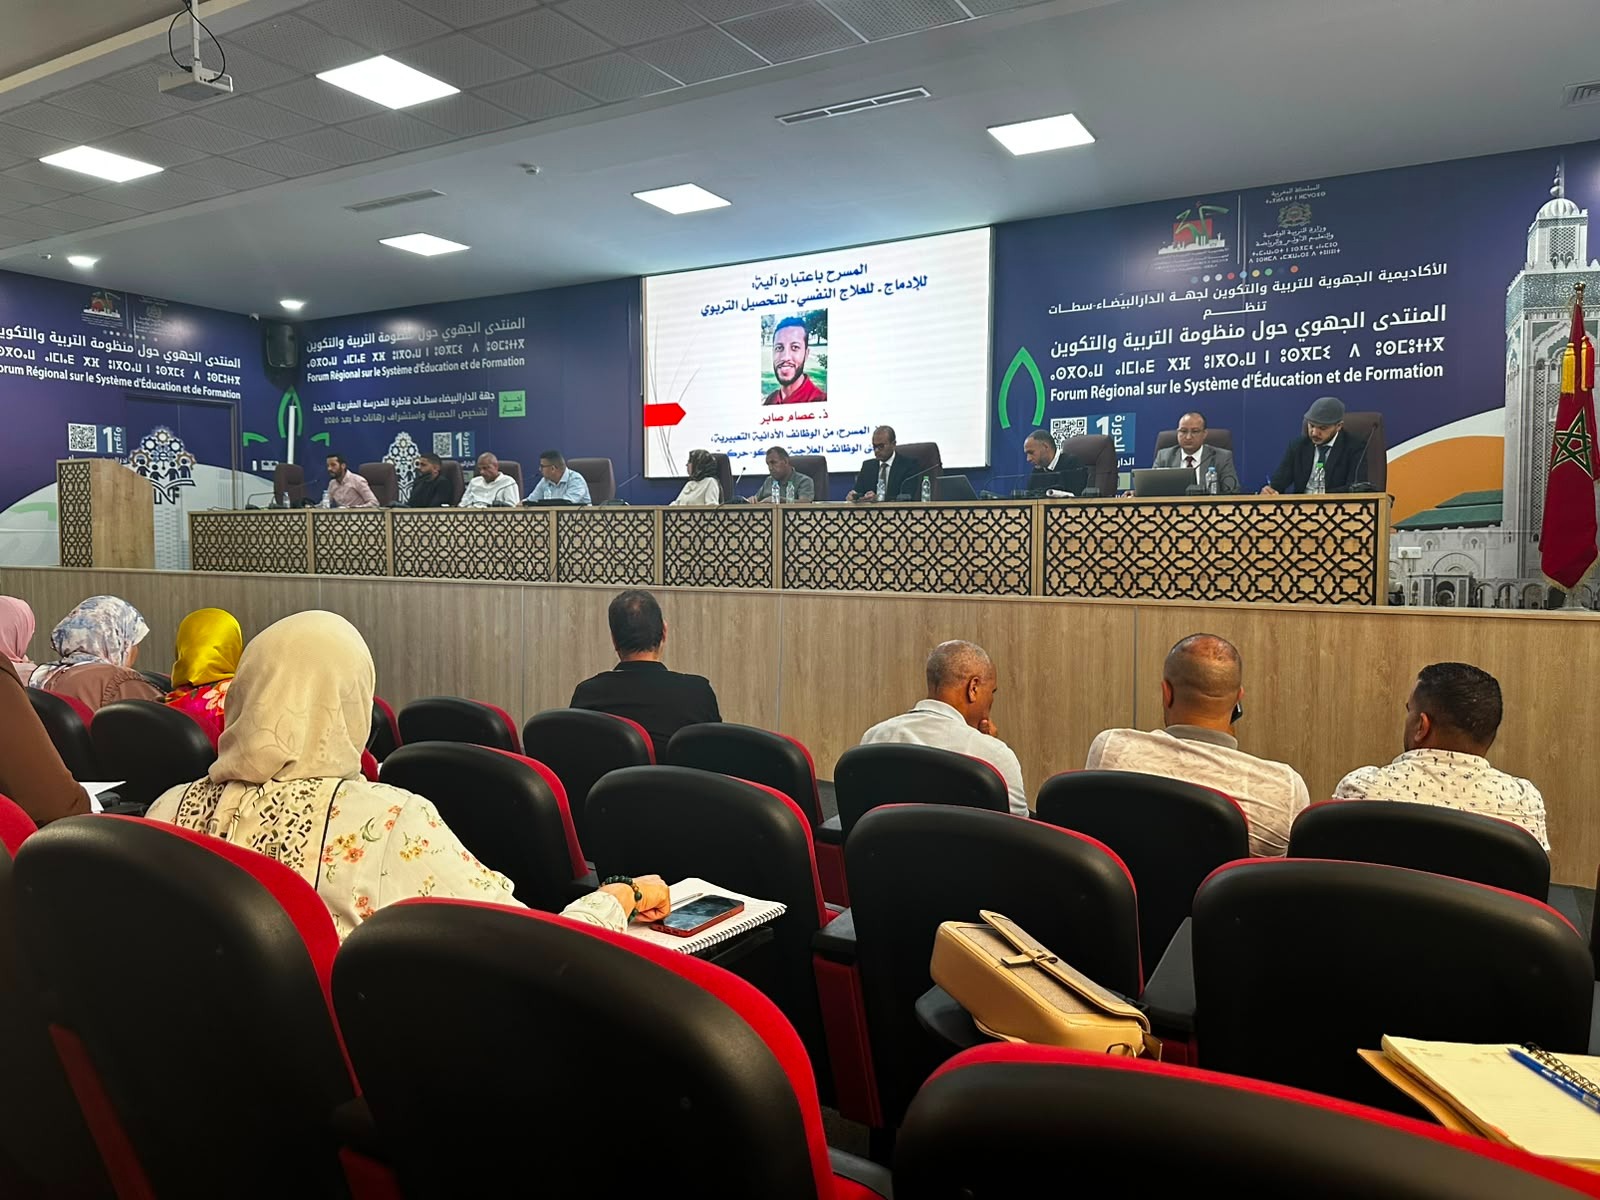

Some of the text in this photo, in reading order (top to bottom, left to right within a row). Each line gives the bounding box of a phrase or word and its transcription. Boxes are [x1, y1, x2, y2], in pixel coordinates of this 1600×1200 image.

[780, 269, 824, 287] باعتباره
[826, 263, 868, 283] المسرح
[1318, 271, 1373, 288] الجهوية
[1378, 263, 1448, 283] الأكاديمية
[840, 282, 874, 301] للعلاج
[884, 275, 928, 294] للإدماج
[1213, 282, 1268, 300] والتكوين
[1272, 277, 1314, 294] للتربية
[741, 294, 788, 311] للتحصيل
[797, 288, 836, 307] النفسي
[700, 300, 739, 317] التربوي
[418, 328, 438, 341] حول
[441, 321, 481, 342] الجهوي
[485, 317, 525, 335] المنتدى
[1050, 304, 1447, 357] المنتدى الجهوي حول منظومة التربية والتكوين
[0, 325, 241, 369] المنتدى الجهوي حول منظومة التربية والتكوي
[306, 336, 345, 353] والتكوين
[347, 332, 375, 348] التربية
[307, 356, 525, 382] Forum Régional sur le Système d'Éducation et de Formation
[0, 364, 241, 399] orum Régional sur le Système d'Éducation et de Formation
[1050, 362, 1444, 402] Forum Régional sur le Système d'Éducation et de Formation
[479, 391, 495, 402] جهة
[760, 412, 784, 425] صابر
[786, 411, 815, 422] عصام
[786, 428, 821, 439] الوظائف
[823, 428, 834, 439] من
[1096, 416, 1109, 436] 1
[1111, 414, 1126, 452] الدورة
[102, 426, 113, 453] 1
[456, 432, 463, 457] 1
[826, 444, 862, 455] الوظائف
